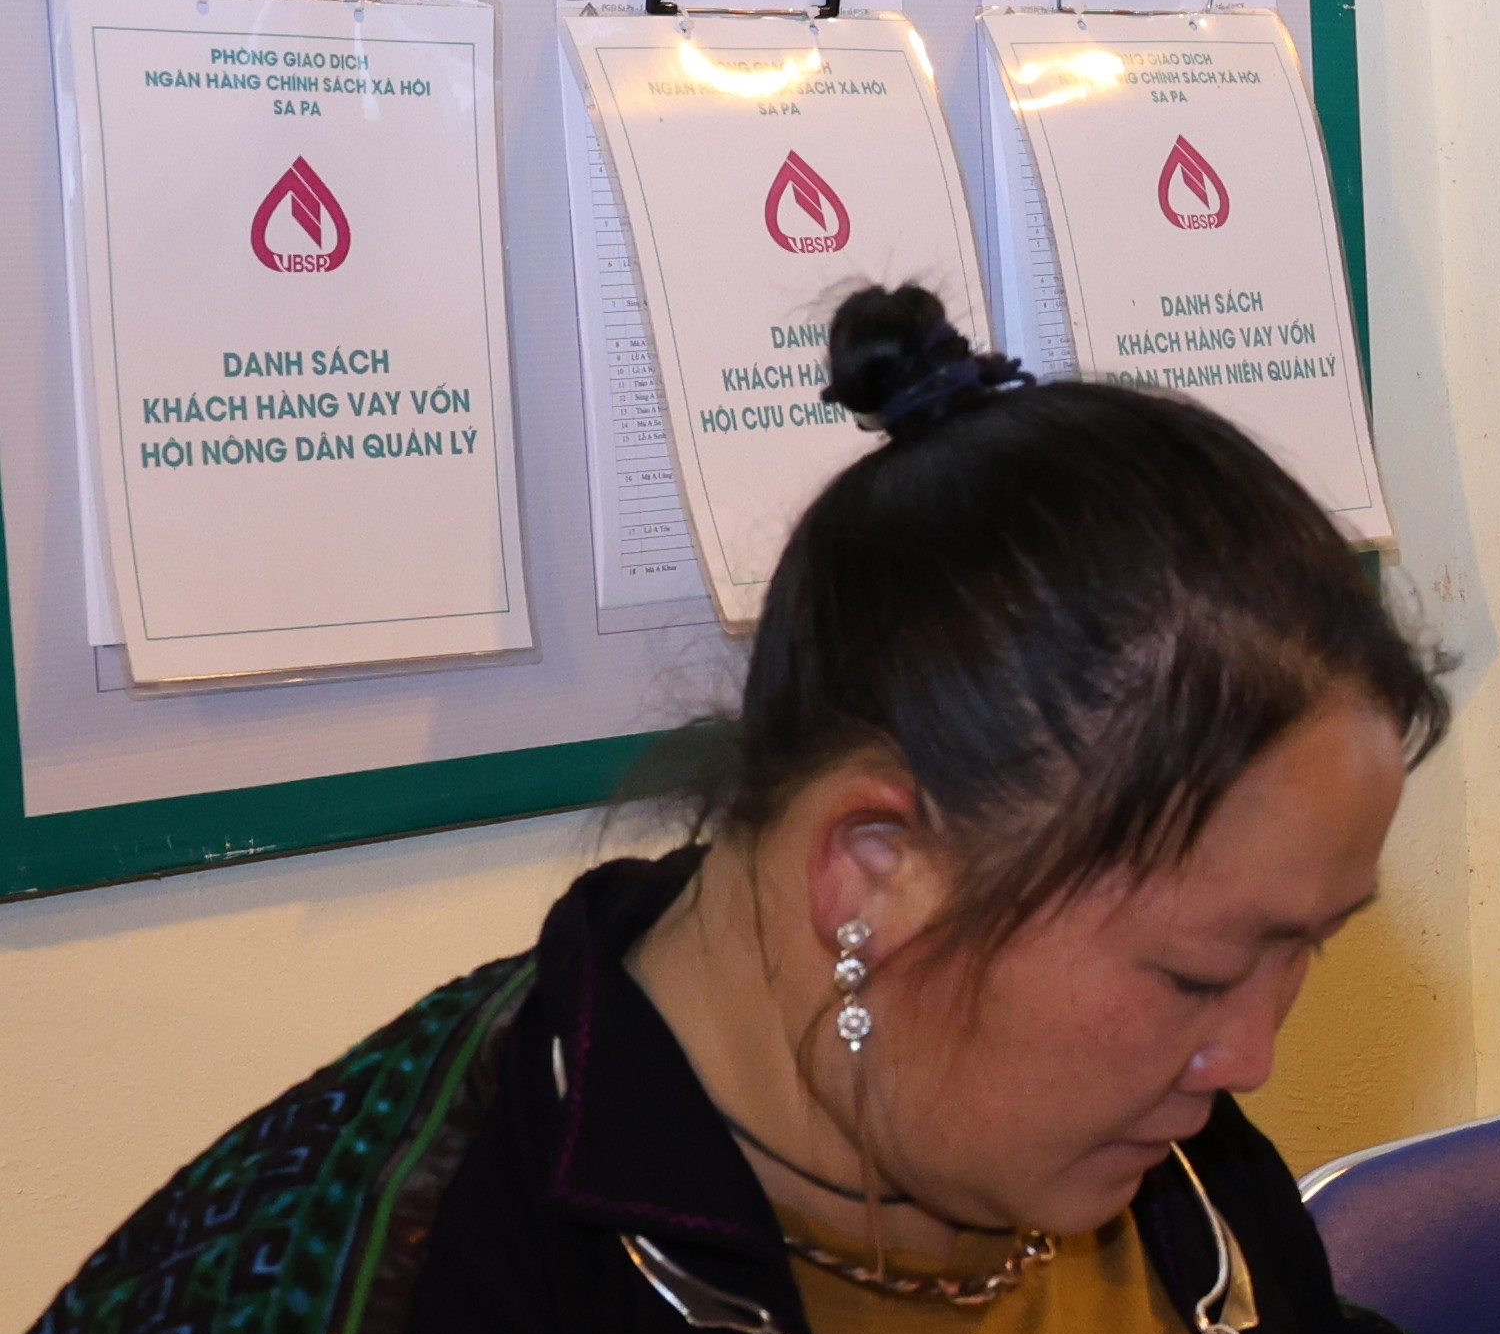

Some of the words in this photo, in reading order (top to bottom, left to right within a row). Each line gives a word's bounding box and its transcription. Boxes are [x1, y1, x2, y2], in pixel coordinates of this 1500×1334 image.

[223, 351, 304, 378] DANH
[311, 345, 390, 376] SÁCH
[142, 392, 248, 424] KHÁCH
[256, 390, 340, 420] HÀNG
[347, 391, 401, 417] VAY
[409, 382, 471, 415] VỐN
[141, 437, 193, 470] HỘI
[201, 434, 288, 466] NÔNG
[295, 431, 355, 462] DÂN
[362, 429, 443, 459] QUẢN
[450, 426, 478, 455] LÝ
